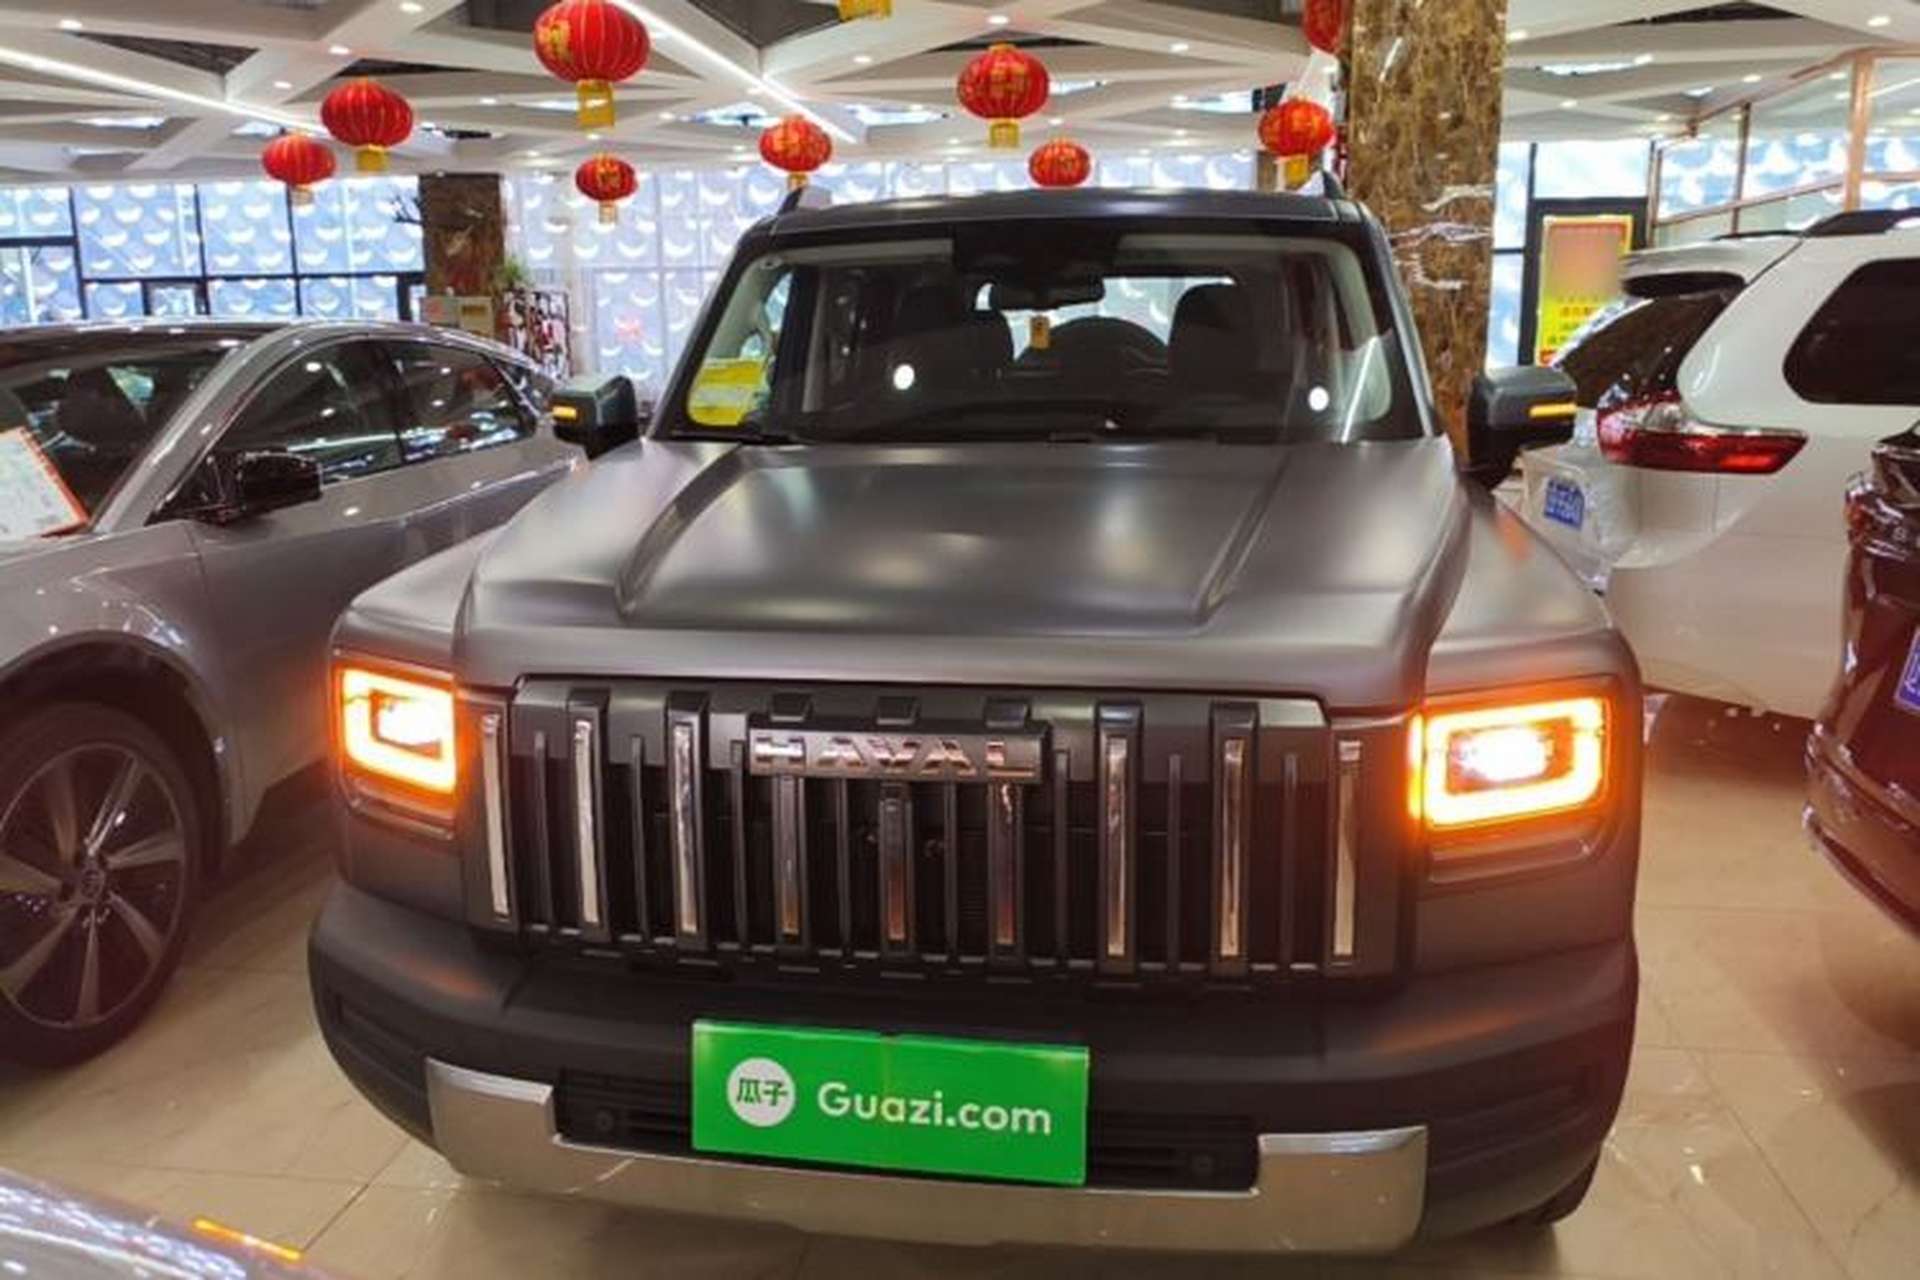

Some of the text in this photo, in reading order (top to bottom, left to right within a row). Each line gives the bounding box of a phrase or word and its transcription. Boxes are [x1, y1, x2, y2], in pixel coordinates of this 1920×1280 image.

[754, 735, 1036, 778] HAVAL
[735, 1076, 788, 1107] 瓜子
[817, 1081, 1052, 1136] Guazi.com
